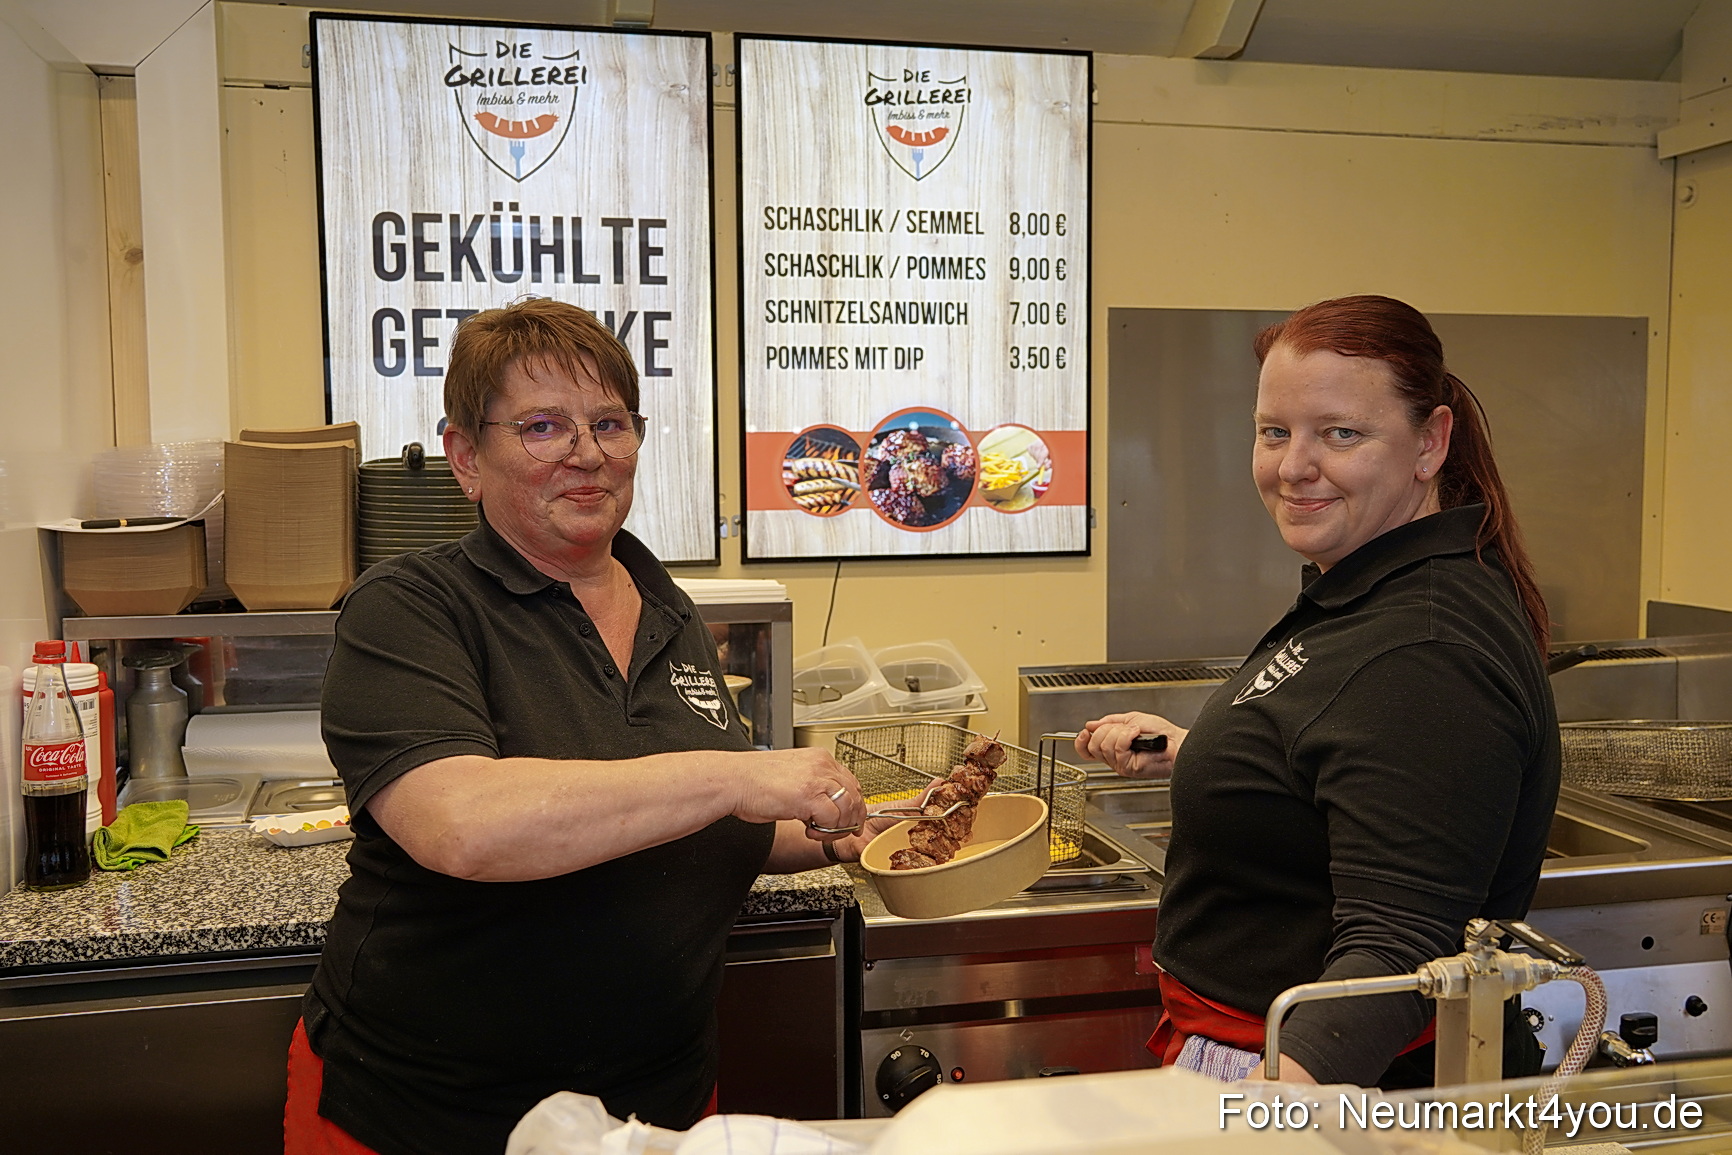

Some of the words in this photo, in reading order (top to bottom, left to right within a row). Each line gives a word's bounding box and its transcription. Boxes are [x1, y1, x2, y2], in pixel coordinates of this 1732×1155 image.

[496, 40, 532, 59] DIE
[444, 65, 587, 88] GRILLEREI
[903, 69, 931, 83] DIE
[476, 93, 514, 106] Imbiss
[516, 92, 526, 105] &
[527, 91, 560, 105] mehr
[864, 88, 971, 106] GRILLEREI
[888, 109, 916, 120] Imbiss
[918, 109, 925, 120] &
[926, 108, 951, 119] mehr
[764, 206, 884, 233] SCHASCHLIK
[906, 210, 985, 235] SEMMEL
[1009, 213, 1050, 236] 8,00
[372, 202, 668, 286] GEKÜHLTE
[764, 253, 884, 279] SCHASCHLIK
[907, 257, 987, 280] POMMES
[1009, 257, 1050, 282] 9,00
[765, 300, 968, 325] SCHNITZELSANDWICH
[1009, 302, 1050, 326] 7,00
[766, 346, 849, 370] POMMES
[855, 347, 888, 370] MIT
[894, 348, 924, 370] DIP
[1009, 346, 1050, 370] 3,50
[681, 662, 697, 673] DIE
[30, 742, 84, 767] Coca-Cola
